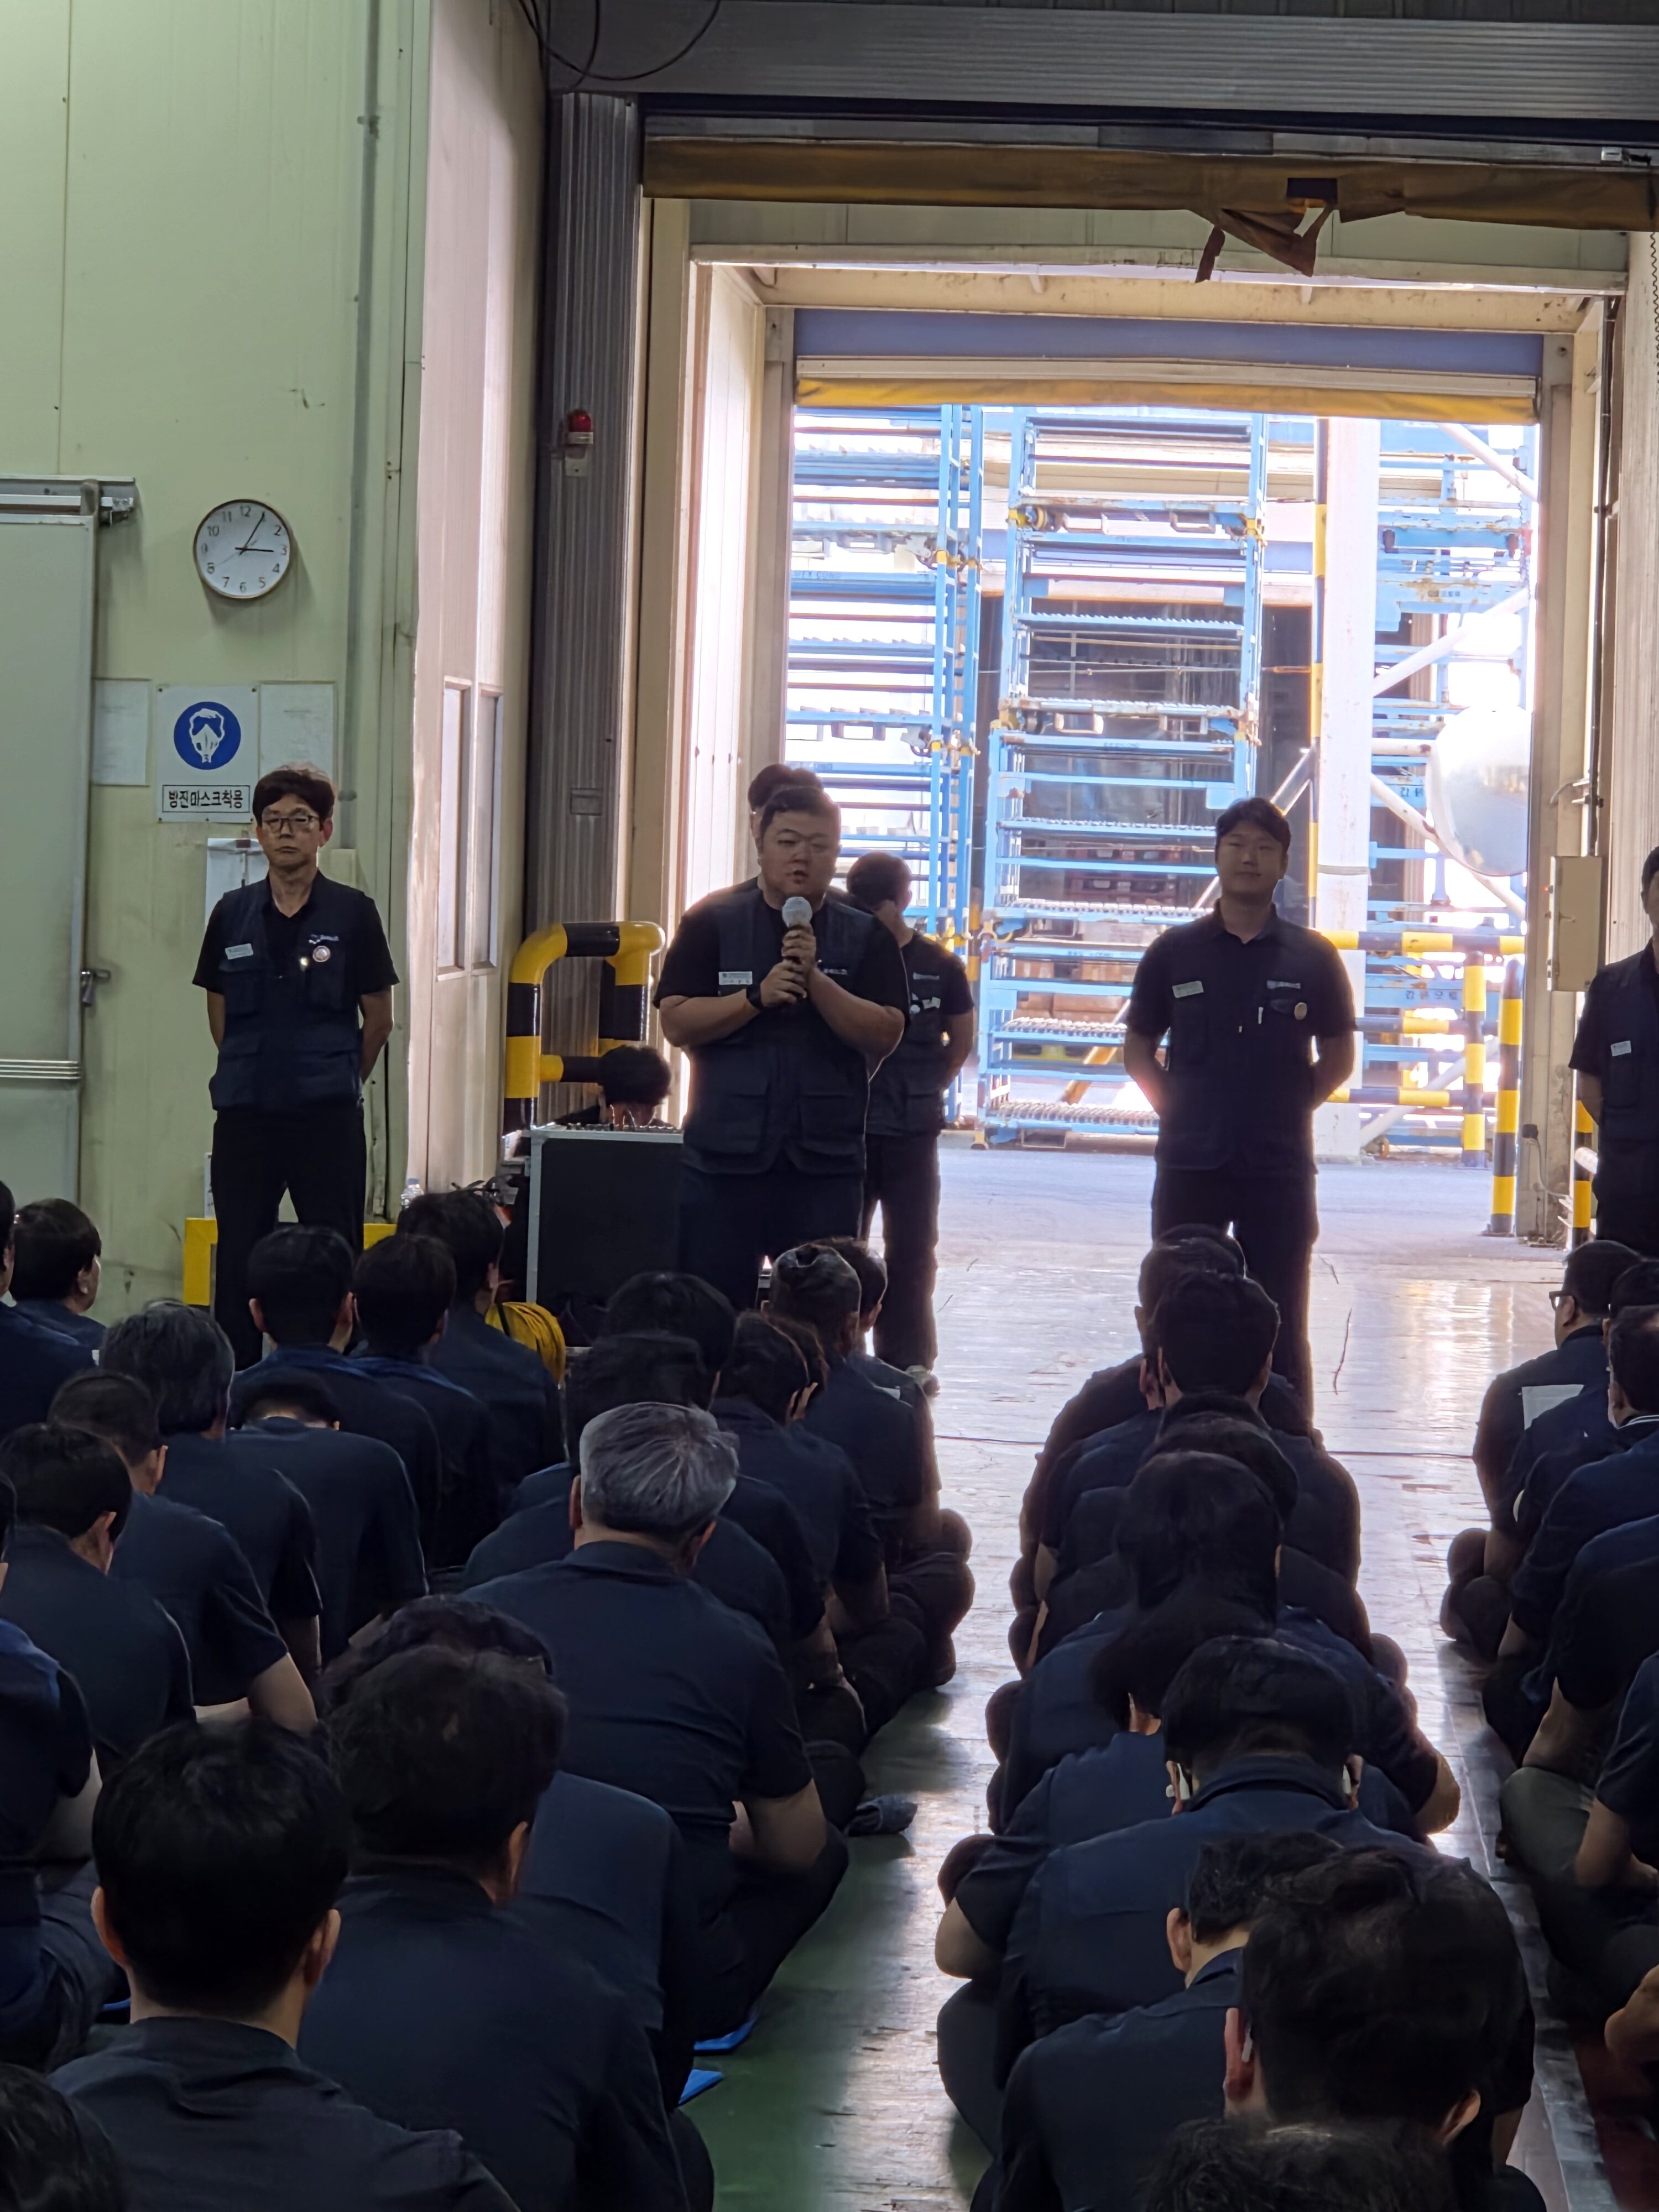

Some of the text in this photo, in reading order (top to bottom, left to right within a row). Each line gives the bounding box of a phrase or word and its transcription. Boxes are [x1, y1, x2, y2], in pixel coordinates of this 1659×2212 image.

[239, 505, 251, 517] 12
[222, 511, 232, 523] 11
[207, 526, 220, 536] 10
[274, 525, 282, 536] 2
[280, 545, 287, 555] 3
[207, 562, 215, 574] 8
[272, 564, 280, 573] 4
[222, 577, 229, 588] 7
[239, 582, 247, 593] 6
[258, 577, 266, 588] 5
